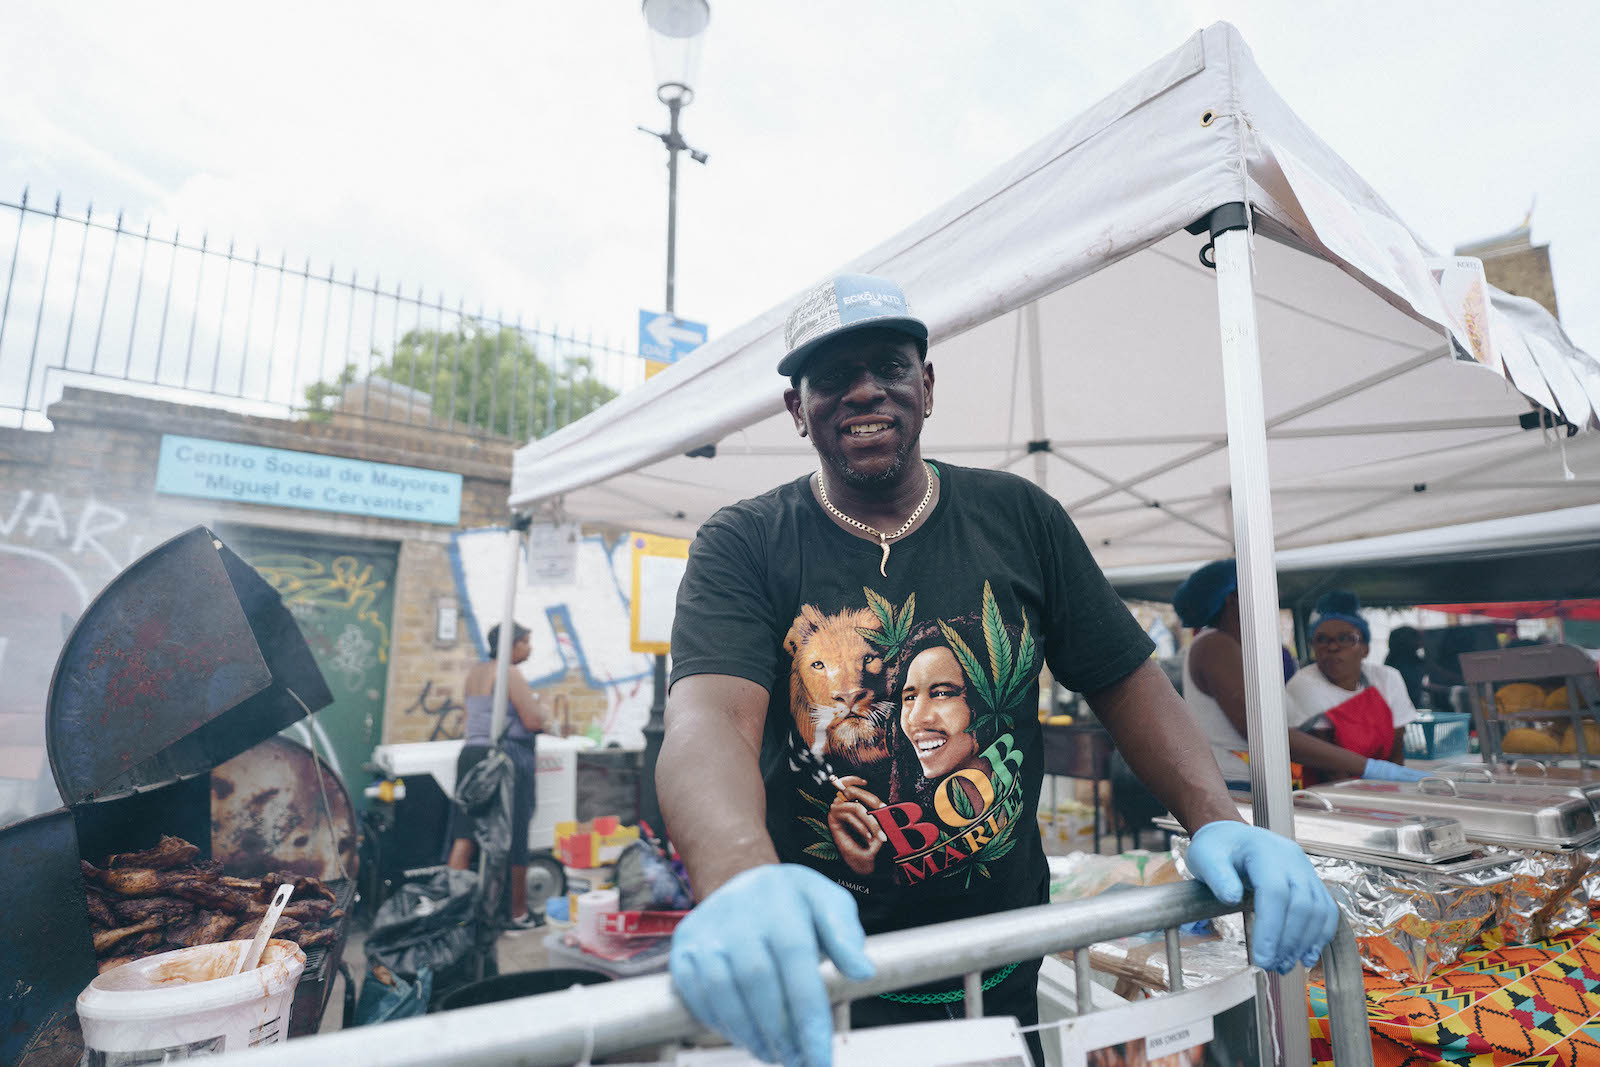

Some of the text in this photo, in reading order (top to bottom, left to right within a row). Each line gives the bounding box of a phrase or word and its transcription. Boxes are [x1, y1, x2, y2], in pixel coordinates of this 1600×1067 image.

[175, 446, 450, 496] Centro Social de Mayores
[288, 484, 314, 499] de
[867, 733, 1024, 860] BOB
[836, 878, 870, 895] JAMAICA
